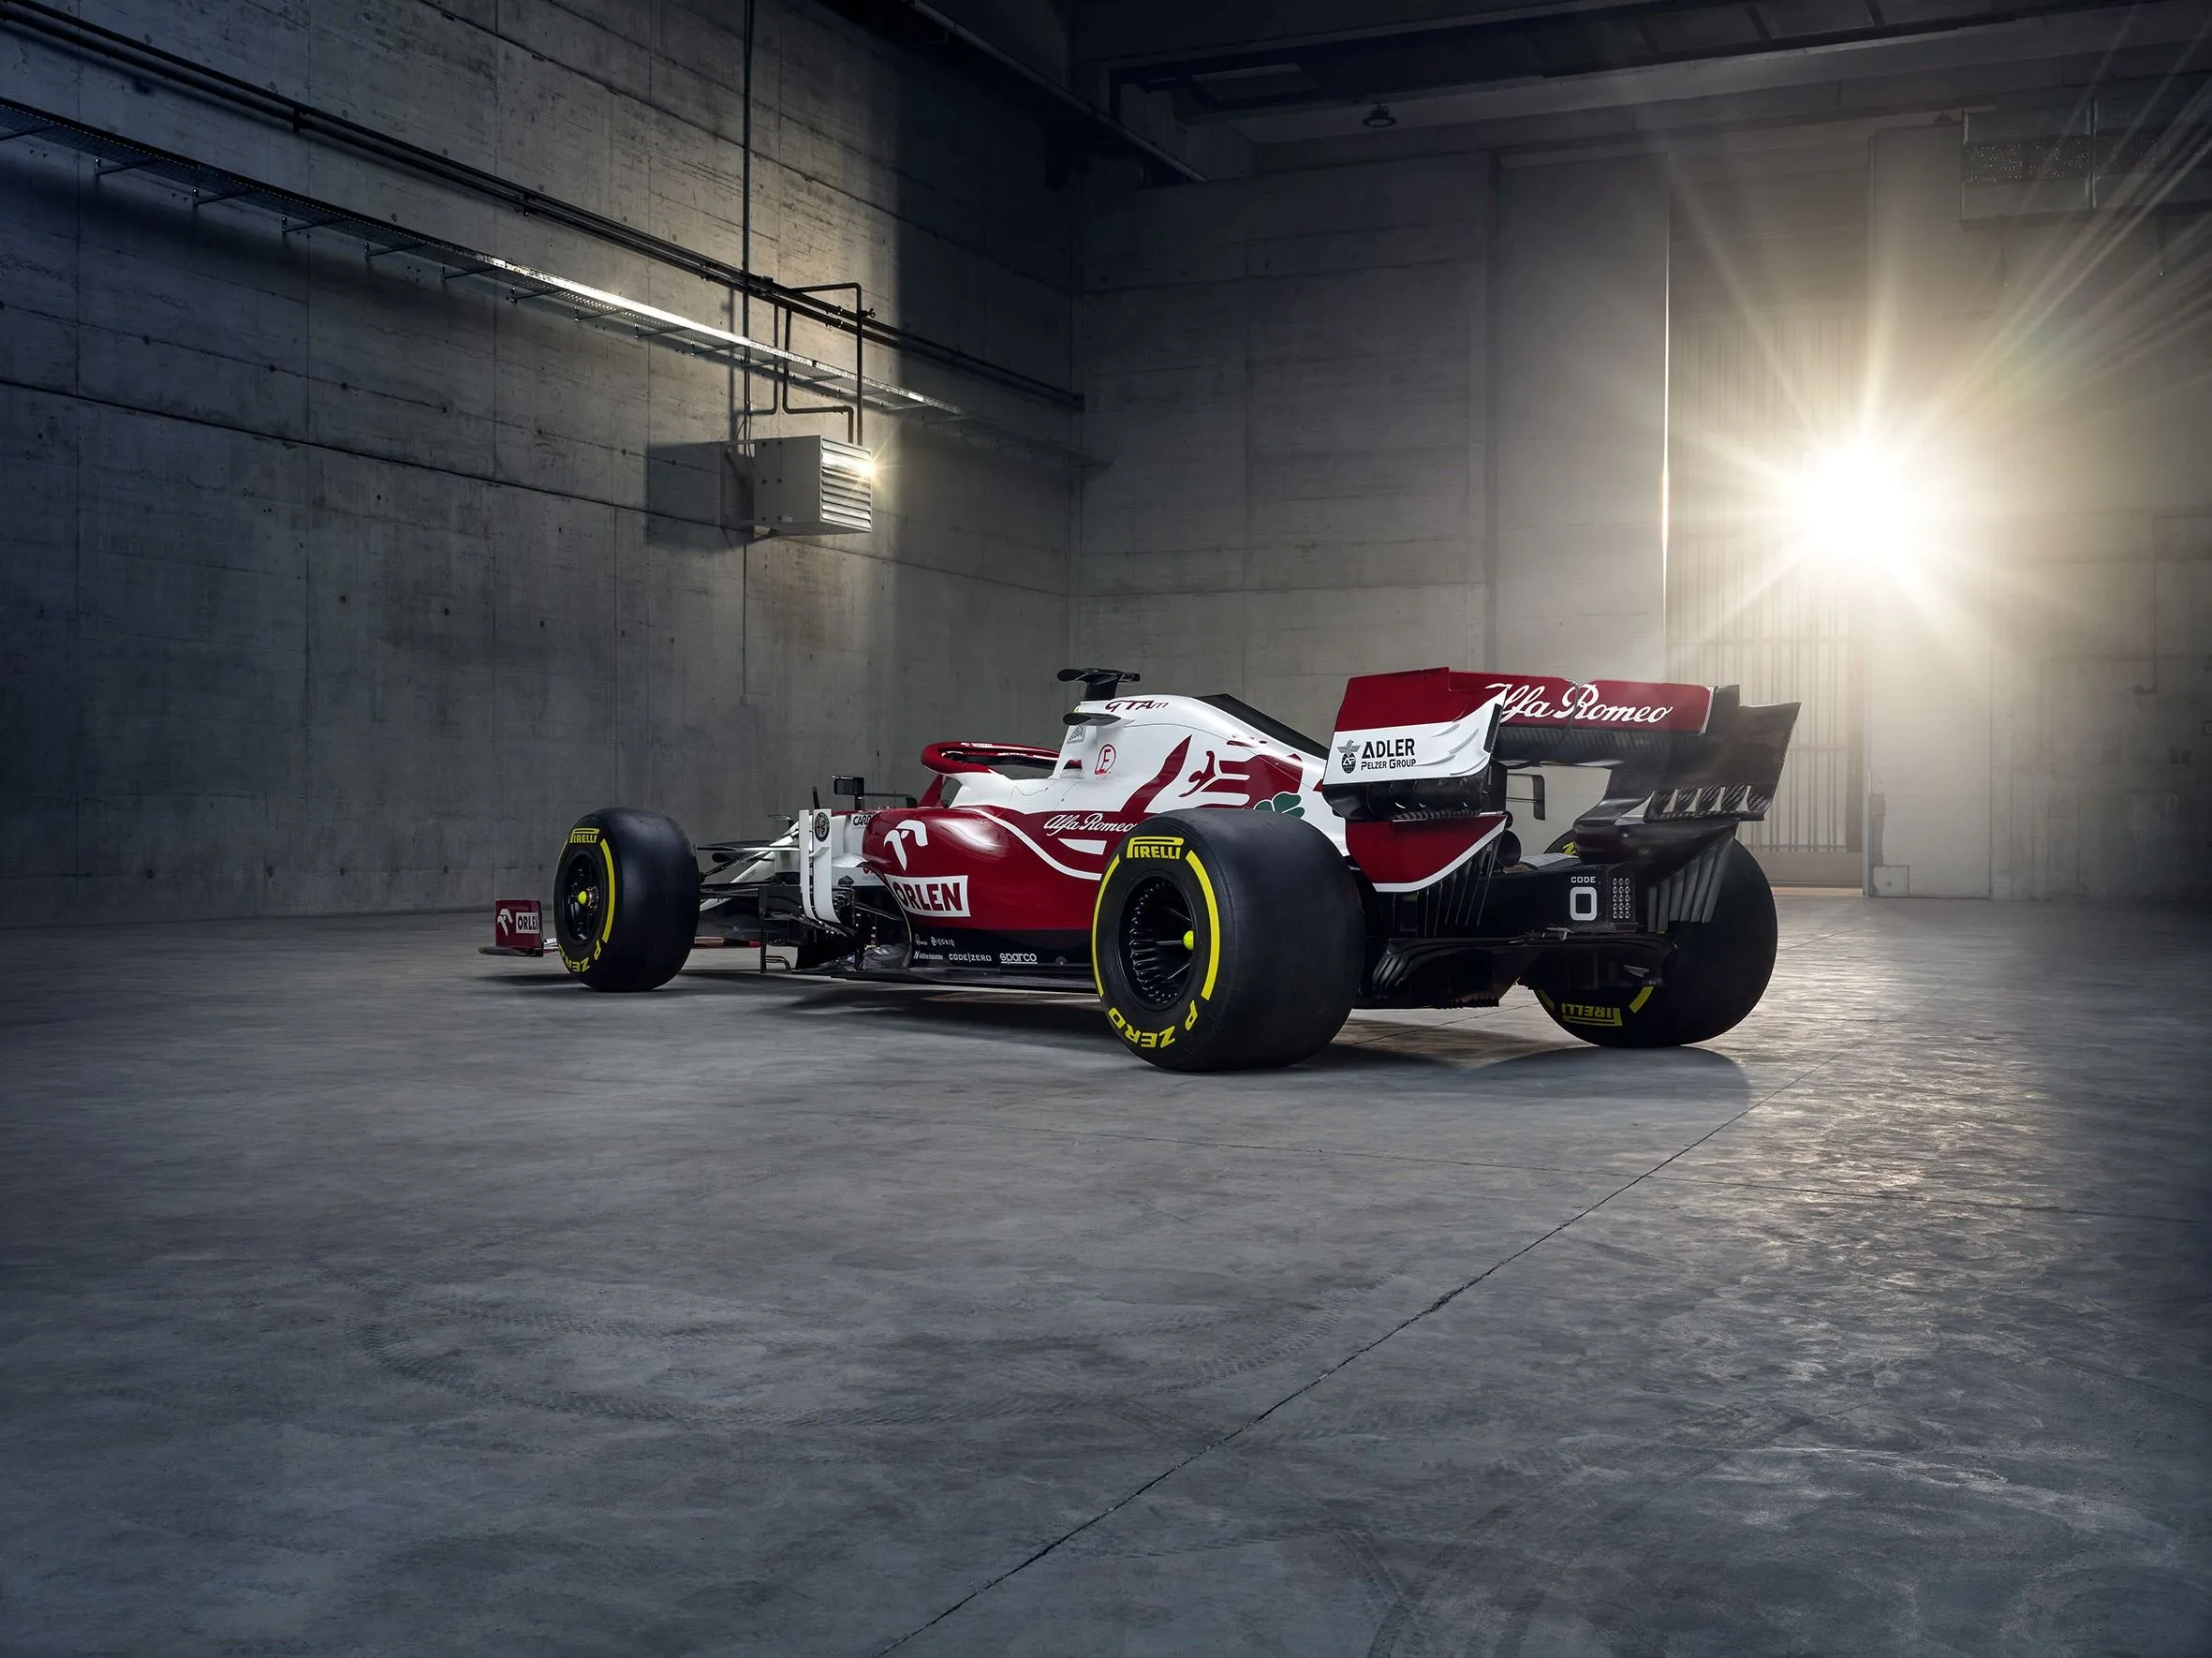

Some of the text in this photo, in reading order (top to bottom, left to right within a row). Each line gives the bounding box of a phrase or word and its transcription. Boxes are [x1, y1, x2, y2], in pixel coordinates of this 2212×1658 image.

[1551, 682, 1674, 724] Romeo
[1361, 738, 1415, 760] ADLER
[569, 827, 600, 844] PIRELLI
[1043, 812, 1138, 836] Alfa Romeo
[1126, 836, 1185, 860] PIRELLI
[892, 881, 964, 911] ORLEN
[999, 952, 1038, 965] sparco
[1108, 999, 1199, 1048] P ZERO
[1560, 1002, 1624, 1027] PIRELLI
